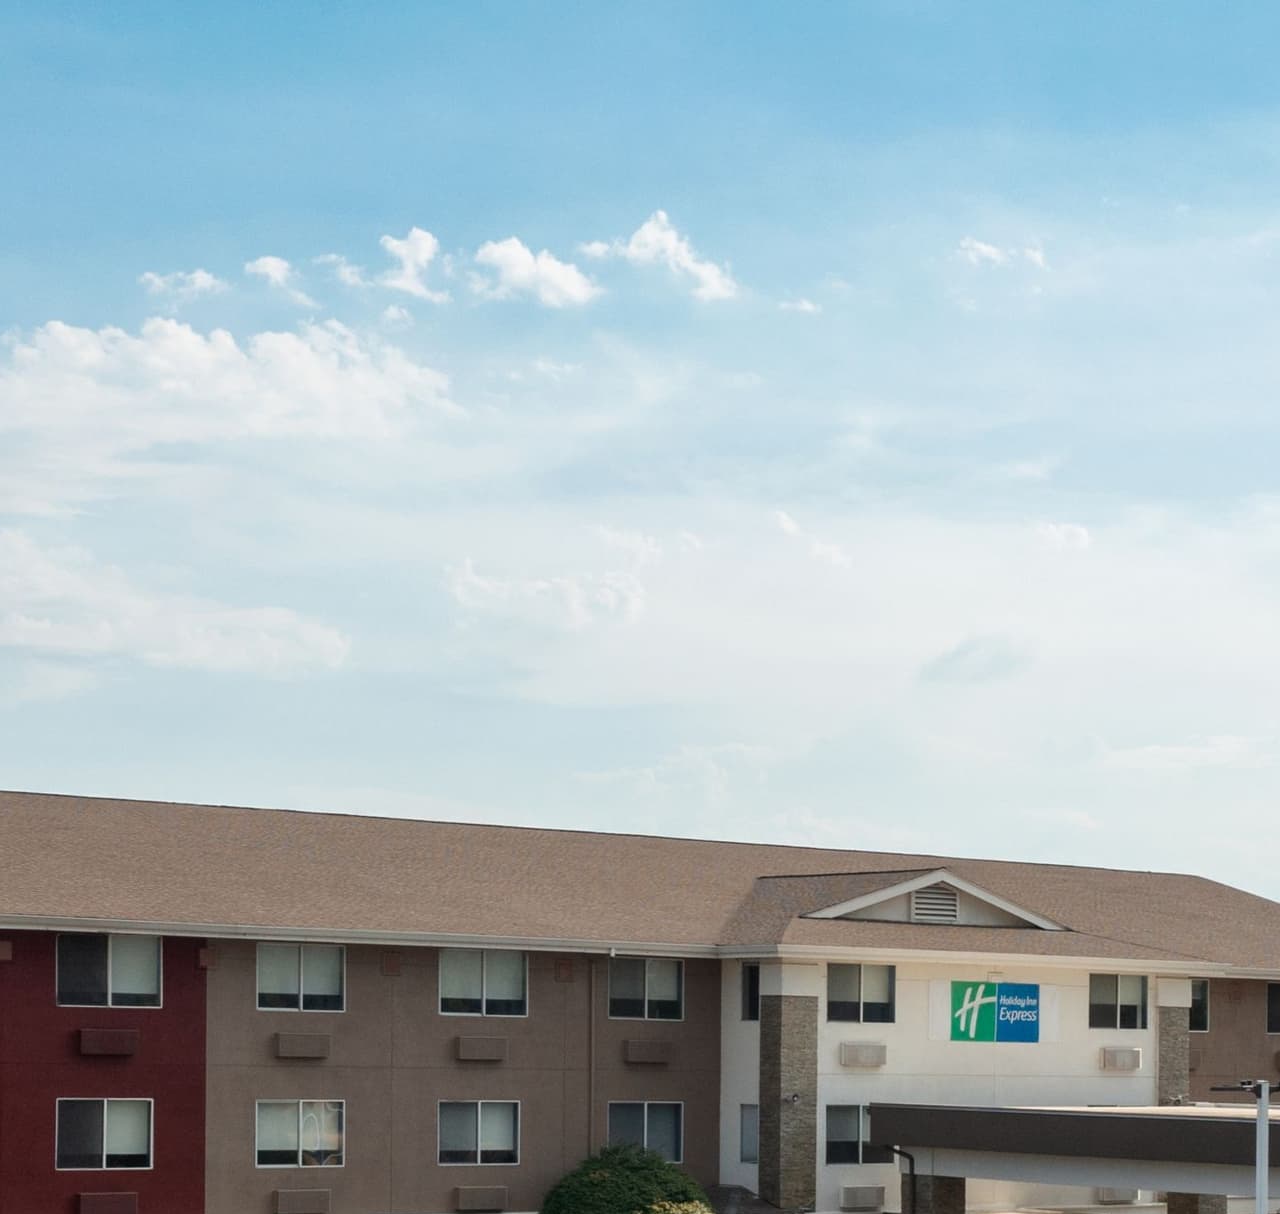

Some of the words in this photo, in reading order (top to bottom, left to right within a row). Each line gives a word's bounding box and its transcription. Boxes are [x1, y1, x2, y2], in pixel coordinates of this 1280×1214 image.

[1000, 995, 1025, 1007] Holiday
[1026, 996, 1037, 1005] Inn
[1000, 1007, 1037, 1024] Express
